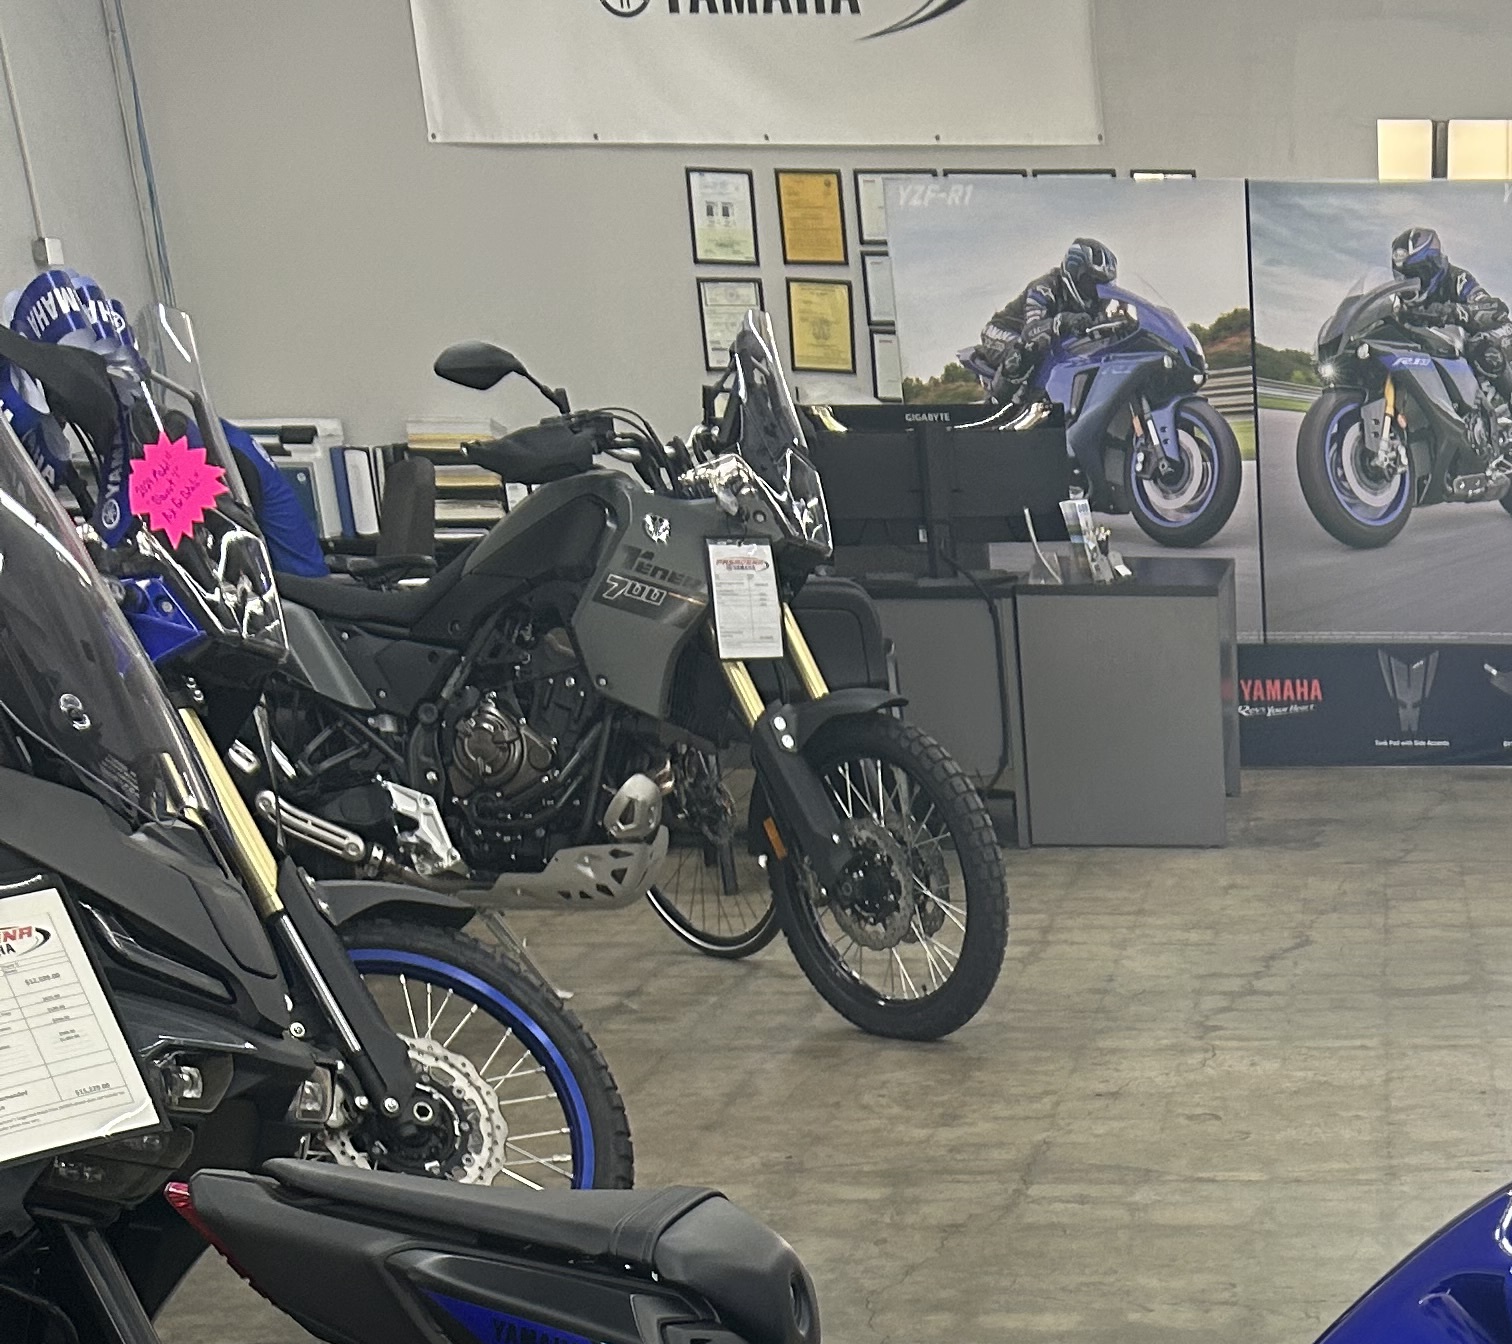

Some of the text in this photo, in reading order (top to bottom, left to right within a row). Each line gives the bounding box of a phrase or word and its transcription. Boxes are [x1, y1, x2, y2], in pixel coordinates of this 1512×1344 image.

[899, 183, 974, 207] YZF-R1
[26, 286, 81, 340] MAHA
[905, 412, 951, 422] GIGABYTE
[603, 574, 667, 605] 700
[1240, 679, 1323, 701] YAMAHA
